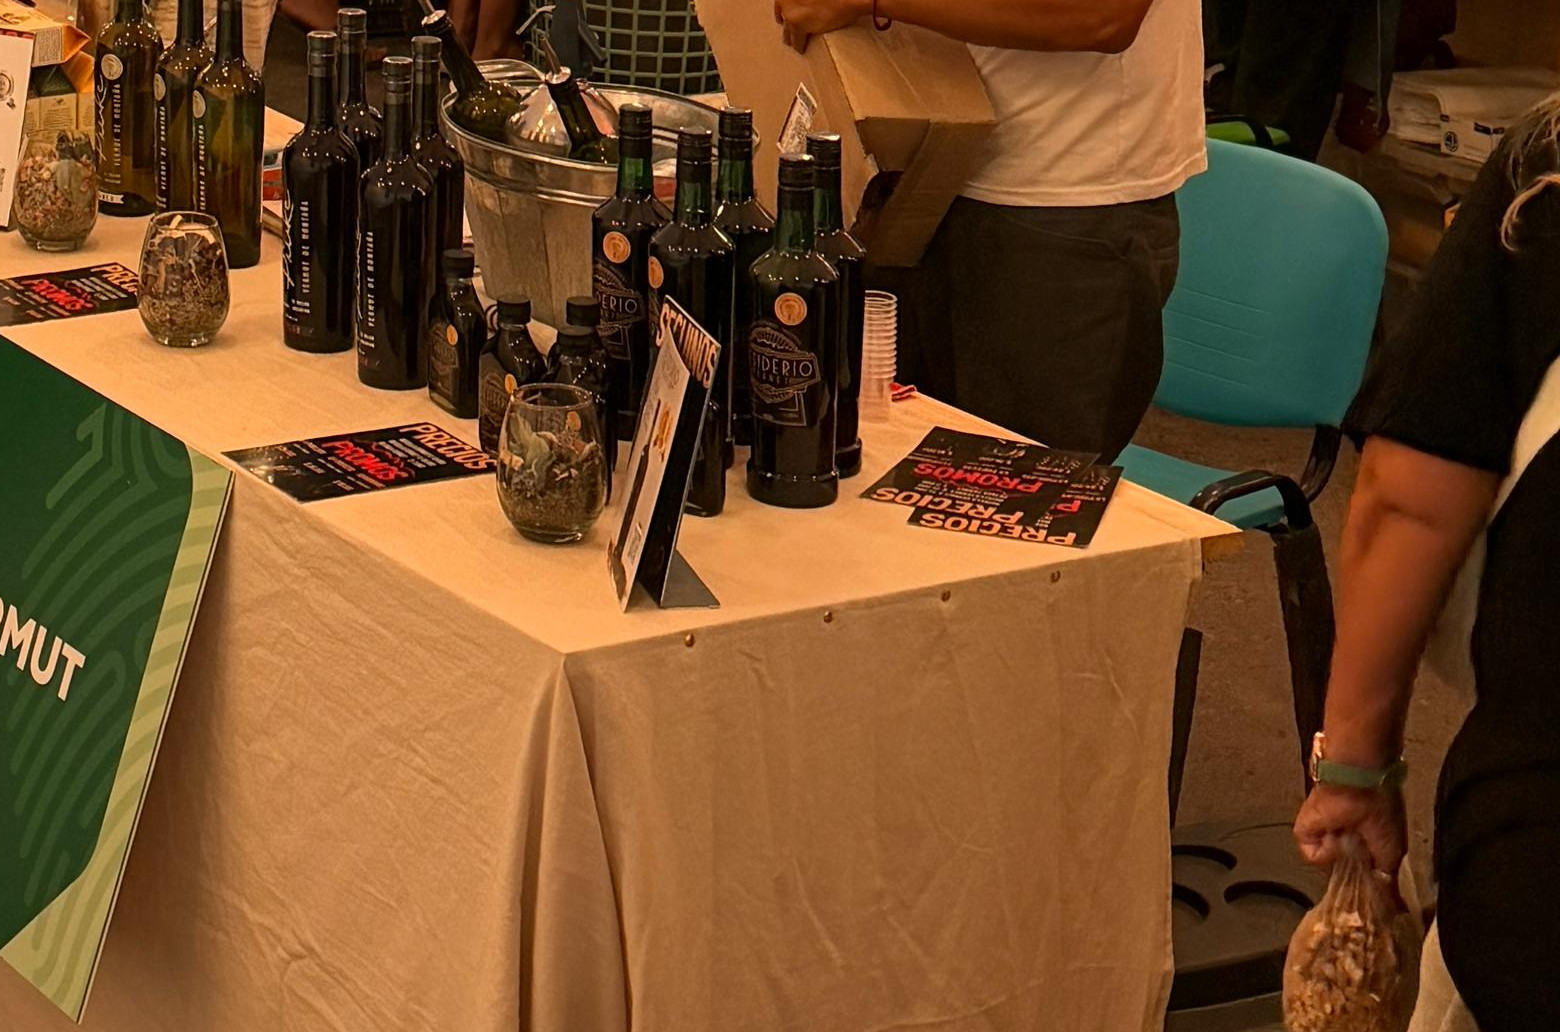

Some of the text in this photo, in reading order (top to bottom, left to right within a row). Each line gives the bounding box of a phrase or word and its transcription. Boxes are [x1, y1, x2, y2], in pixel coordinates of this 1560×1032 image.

[320, 440, 409, 481] PROMOS
[399, 423, 498, 470] PRECIOS
[913, 462, 1044, 494] PROMOS
[872, 487, 1025, 524] PRECIOS
[920, 512, 1077, 547] PRECIOS
